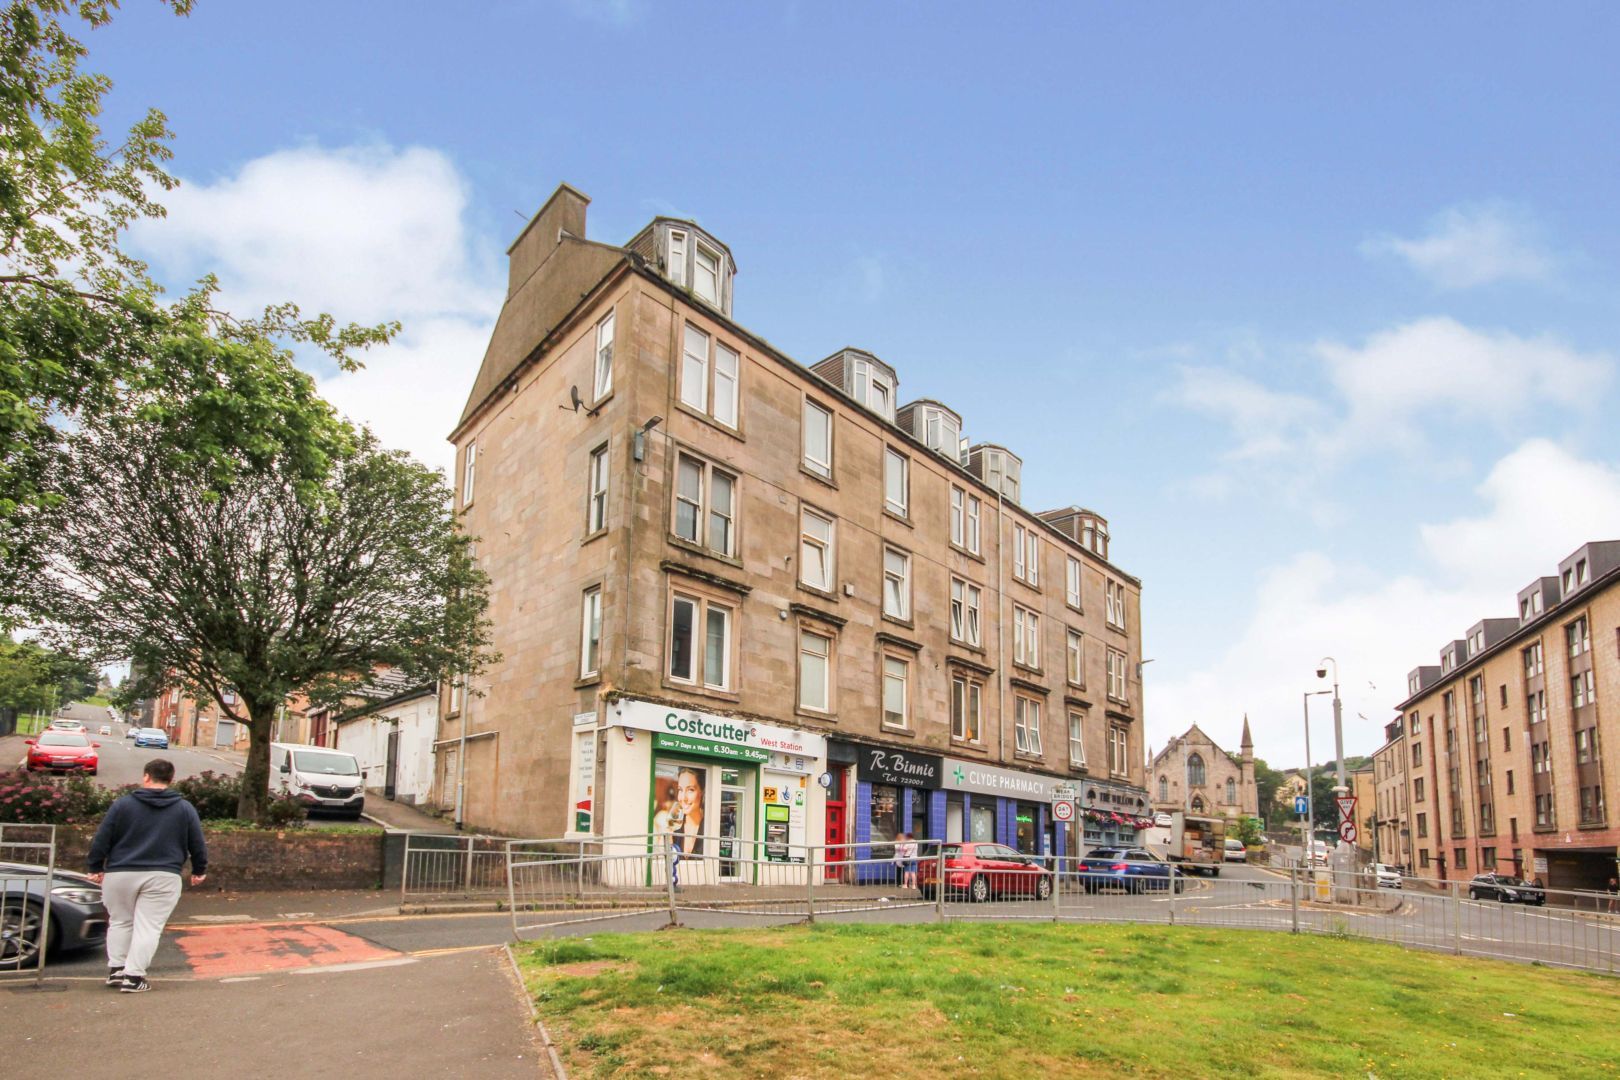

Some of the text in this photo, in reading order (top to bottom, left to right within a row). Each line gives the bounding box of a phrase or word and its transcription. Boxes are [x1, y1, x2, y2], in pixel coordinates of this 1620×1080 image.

[665, 713, 750, 742] Costcutter
[713, 745, 738, 756] 6.30am
[745, 750, 768, 760] 9.45pm
[760, 738, 803, 751] West Station
[870, 750, 934, 777] R. Binnie
[882, 772, 898, 782] Tel
[969, 771, 1044, 794] CLYDE PHARMACY
